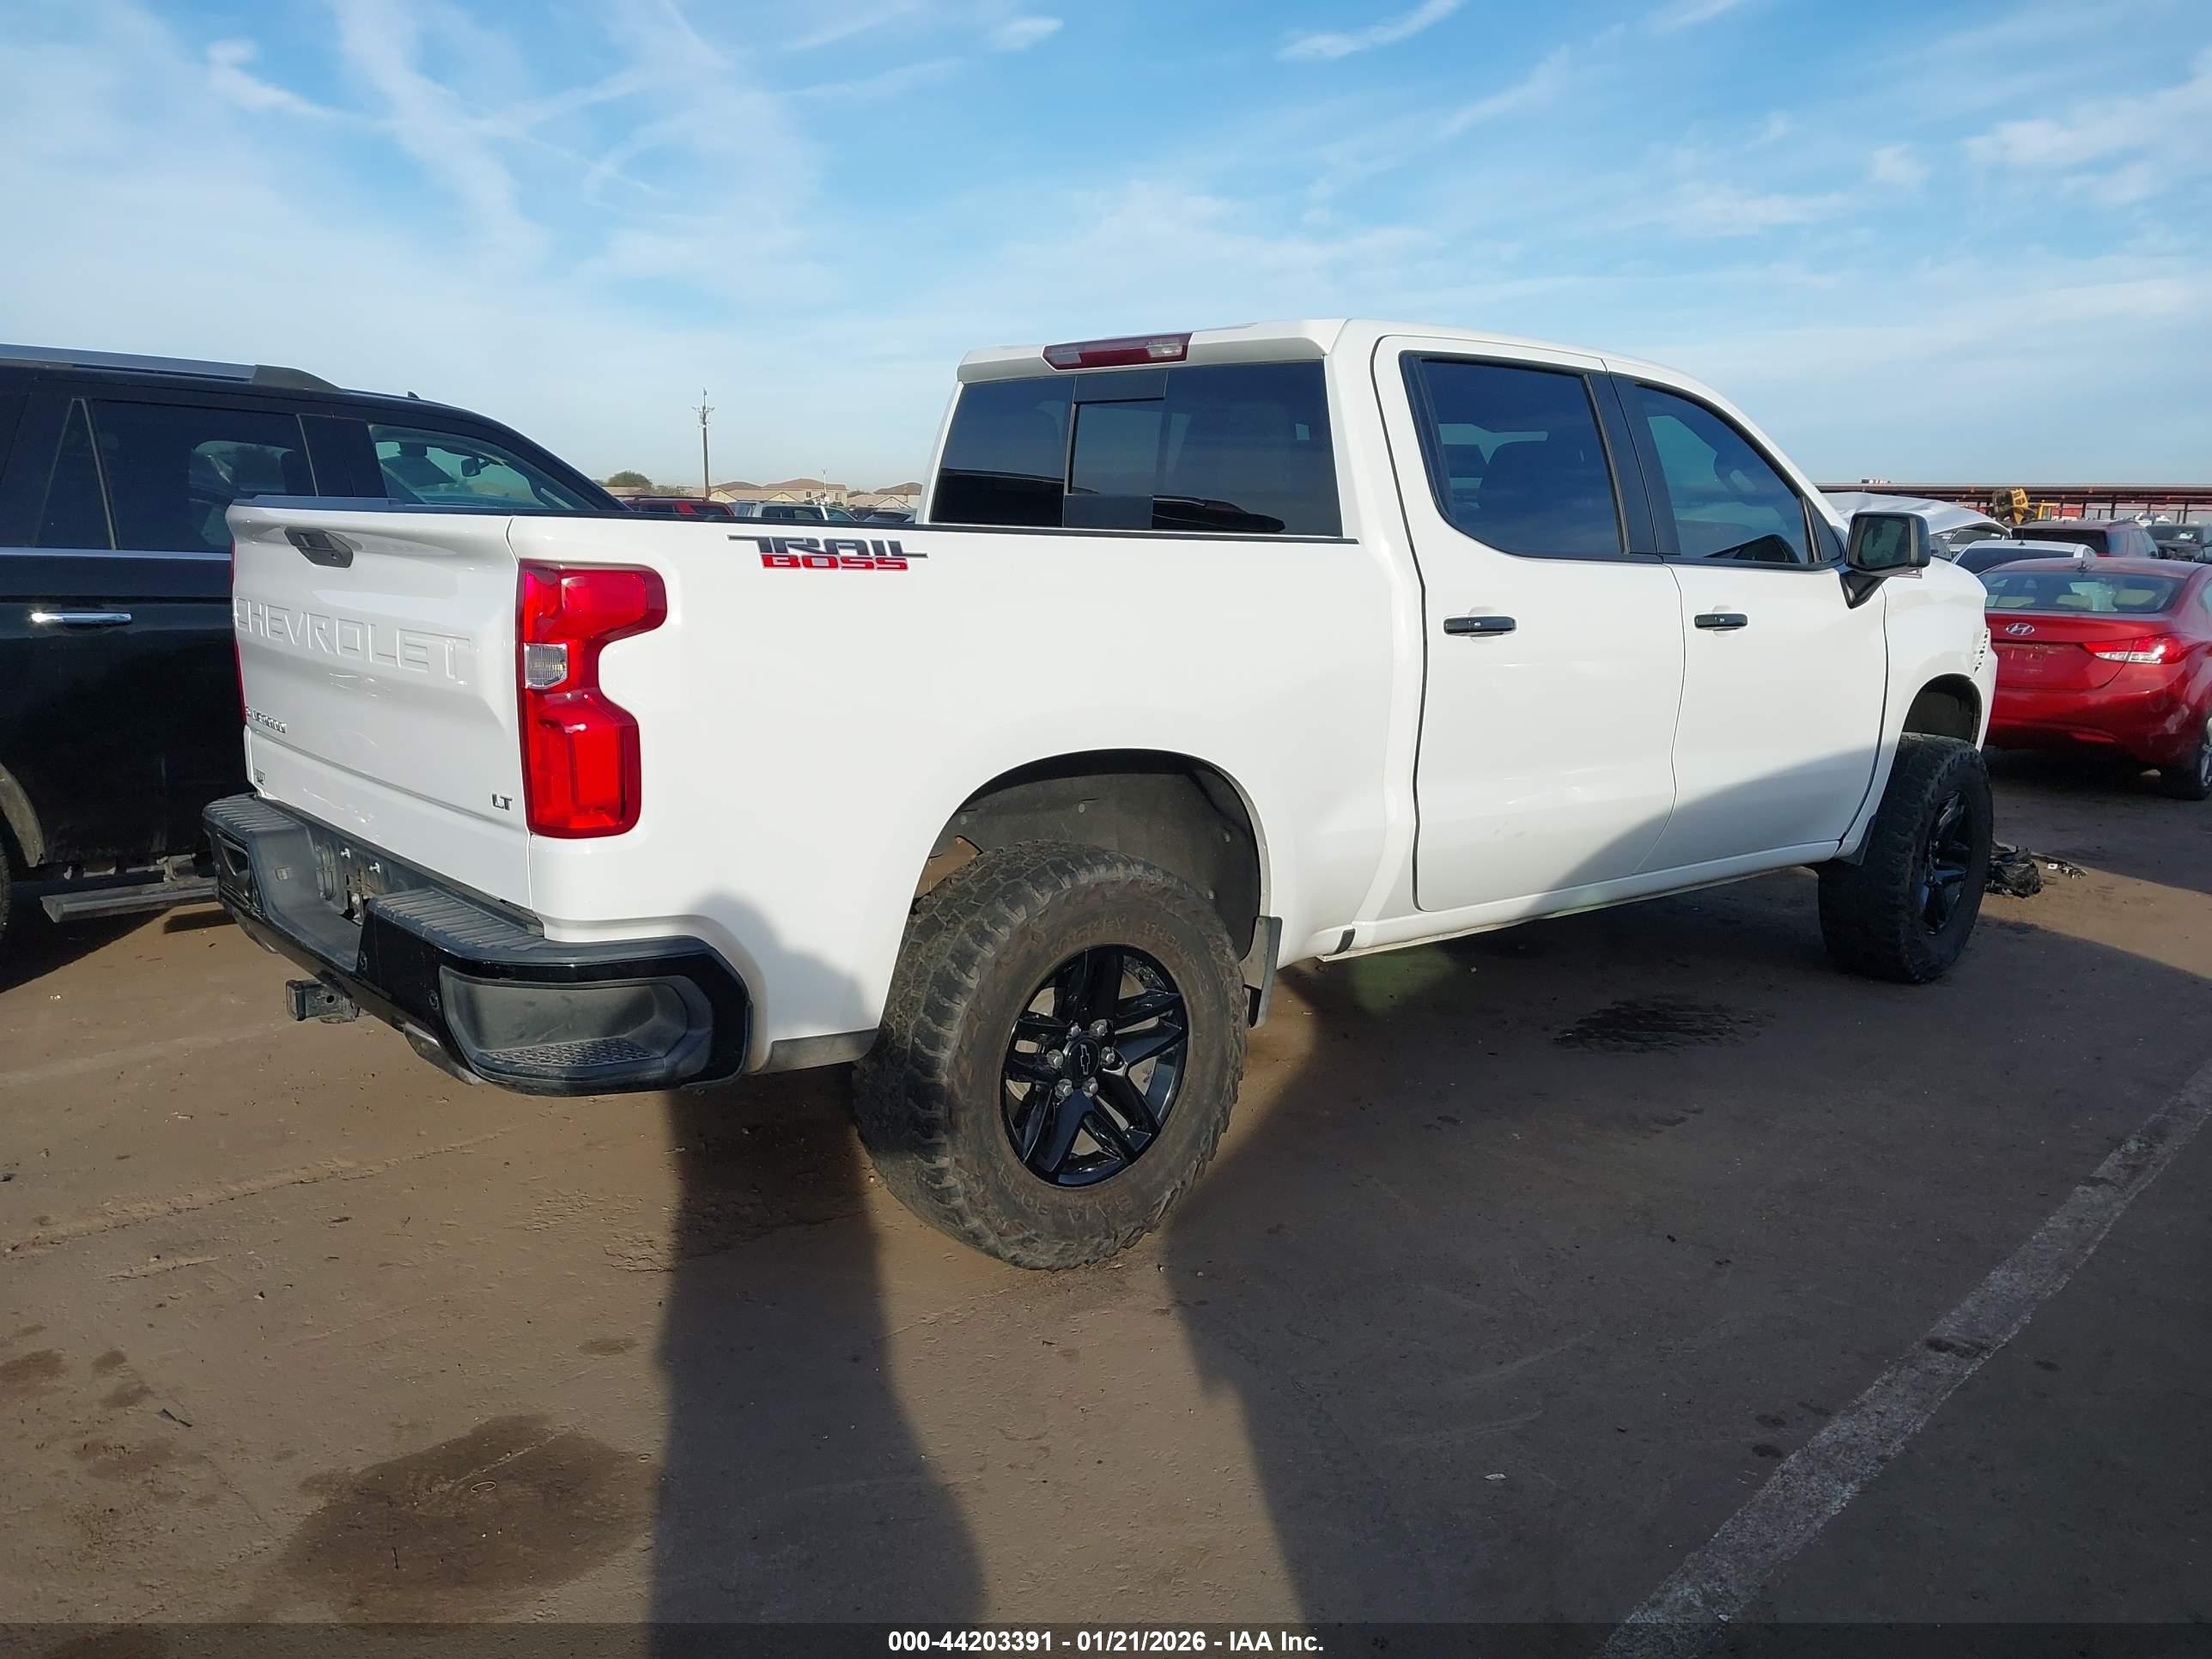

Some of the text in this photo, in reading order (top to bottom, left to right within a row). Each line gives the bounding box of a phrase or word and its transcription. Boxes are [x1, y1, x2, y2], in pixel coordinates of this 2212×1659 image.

[726, 534, 928, 558] TRAIL
[761, 554, 908, 572] BOSS
[233, 595, 471, 680] CHEVROLET
[491, 793, 514, 811] LT
